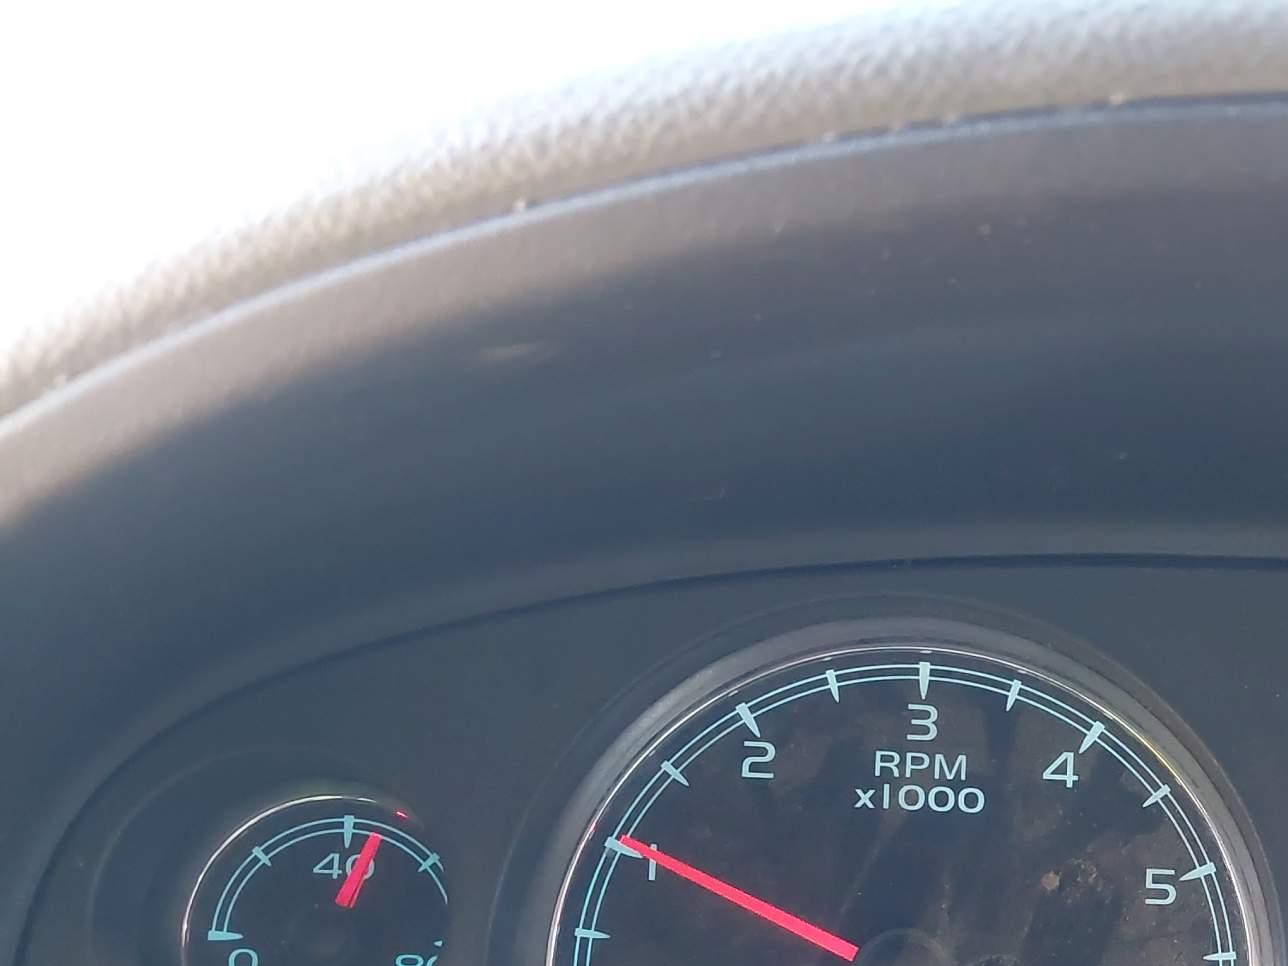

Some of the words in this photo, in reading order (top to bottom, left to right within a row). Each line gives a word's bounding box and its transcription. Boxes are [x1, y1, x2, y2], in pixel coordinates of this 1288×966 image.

[905, 703, 939, 742] 3
[741, 741, 775, 779] 2
[873, 751, 967, 781] RPM
[1043, 752, 1079, 788] 4
[854, 784, 985, 814] x1000
[1145, 869, 1177, 905] 5
